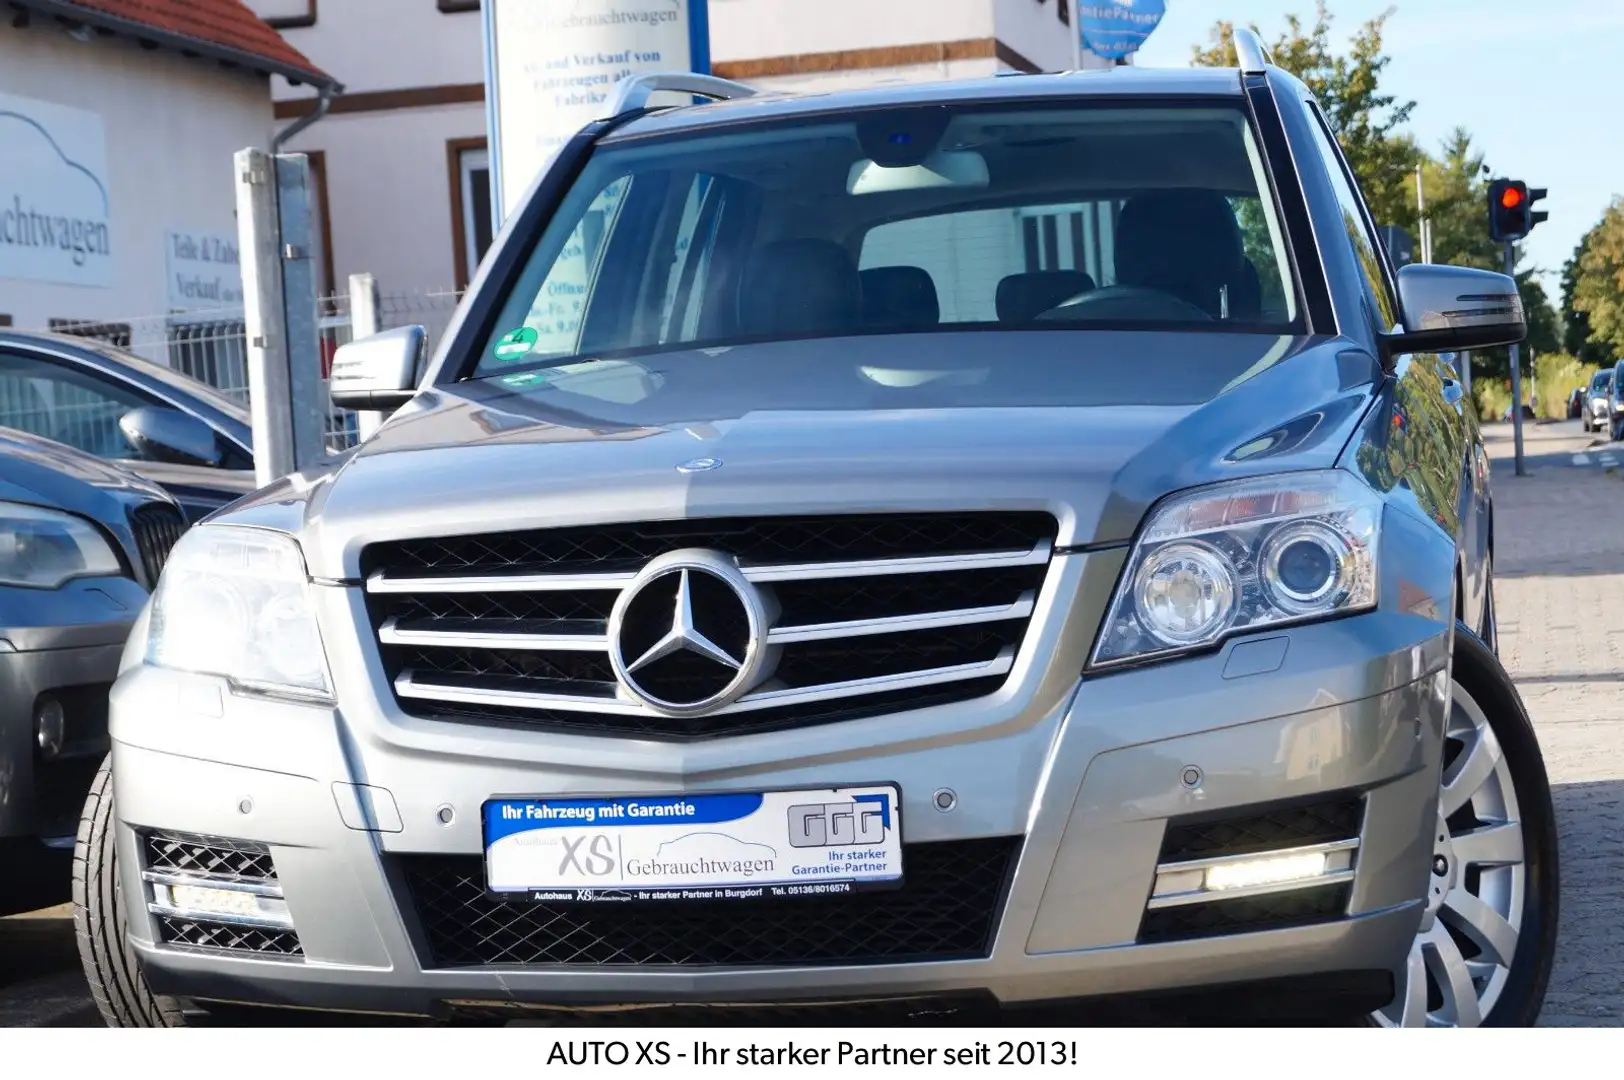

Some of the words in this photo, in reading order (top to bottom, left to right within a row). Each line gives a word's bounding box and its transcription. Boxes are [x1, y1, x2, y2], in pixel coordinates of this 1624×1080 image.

[573, 50, 631, 66] Verkauf
[634, 51, 661, 62] von
[533, 73, 608, 91] Fahrzeugen
[0, 193, 110, 267] chtwagen
[512, 329, 525, 344] 4
[502, 804, 523, 820] Ihr
[526, 803, 596, 822] Fahrzeug
[598, 803, 625, 818] mit
[627, 801, 696, 817] Garantie
[558, 833, 616, 877] XS
[828, 850, 846, 861] Ihr
[847, 849, 888, 861] starker
[626, 856, 775, 877] Gebrauchtwagen
[791, 862, 888, 876] Garantie-Partner
[534, 891, 573, 901] Autohaus
[576, 888, 593, 902] XS
[639, 891, 650, 900] Ihr
[651, 890, 681, 900] starker
[682, 890, 713, 899] Partner
[714, 889, 723, 898] in
[725, 887, 763, 899] Burgdorf
[770, 886, 786, 896] Tel.
